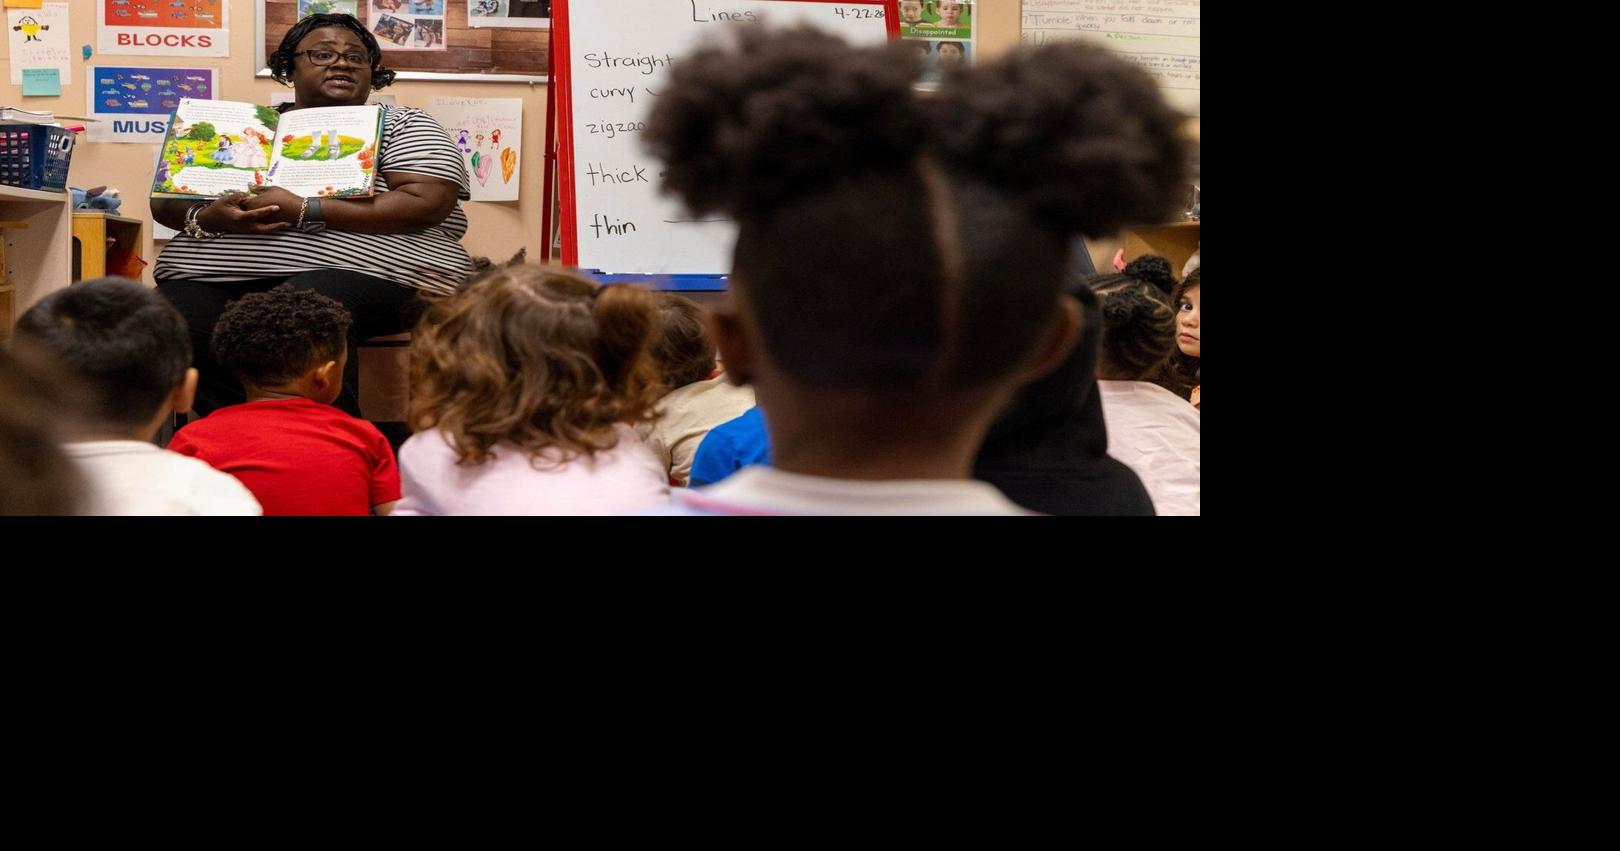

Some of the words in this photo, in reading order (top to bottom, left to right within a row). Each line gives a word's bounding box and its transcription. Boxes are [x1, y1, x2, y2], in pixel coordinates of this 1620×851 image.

[691, 0, 757, 22] Lines
[117, 33, 212, 48] BLOCKS
[910, 27, 957, 36] Disappointed
[583, 51, 675, 75] Straight
[590, 85, 635, 103] curvy
[113, 121, 170, 134] MUS
[586, 163, 648, 186] thick
[589, 214, 636, 239] thin
